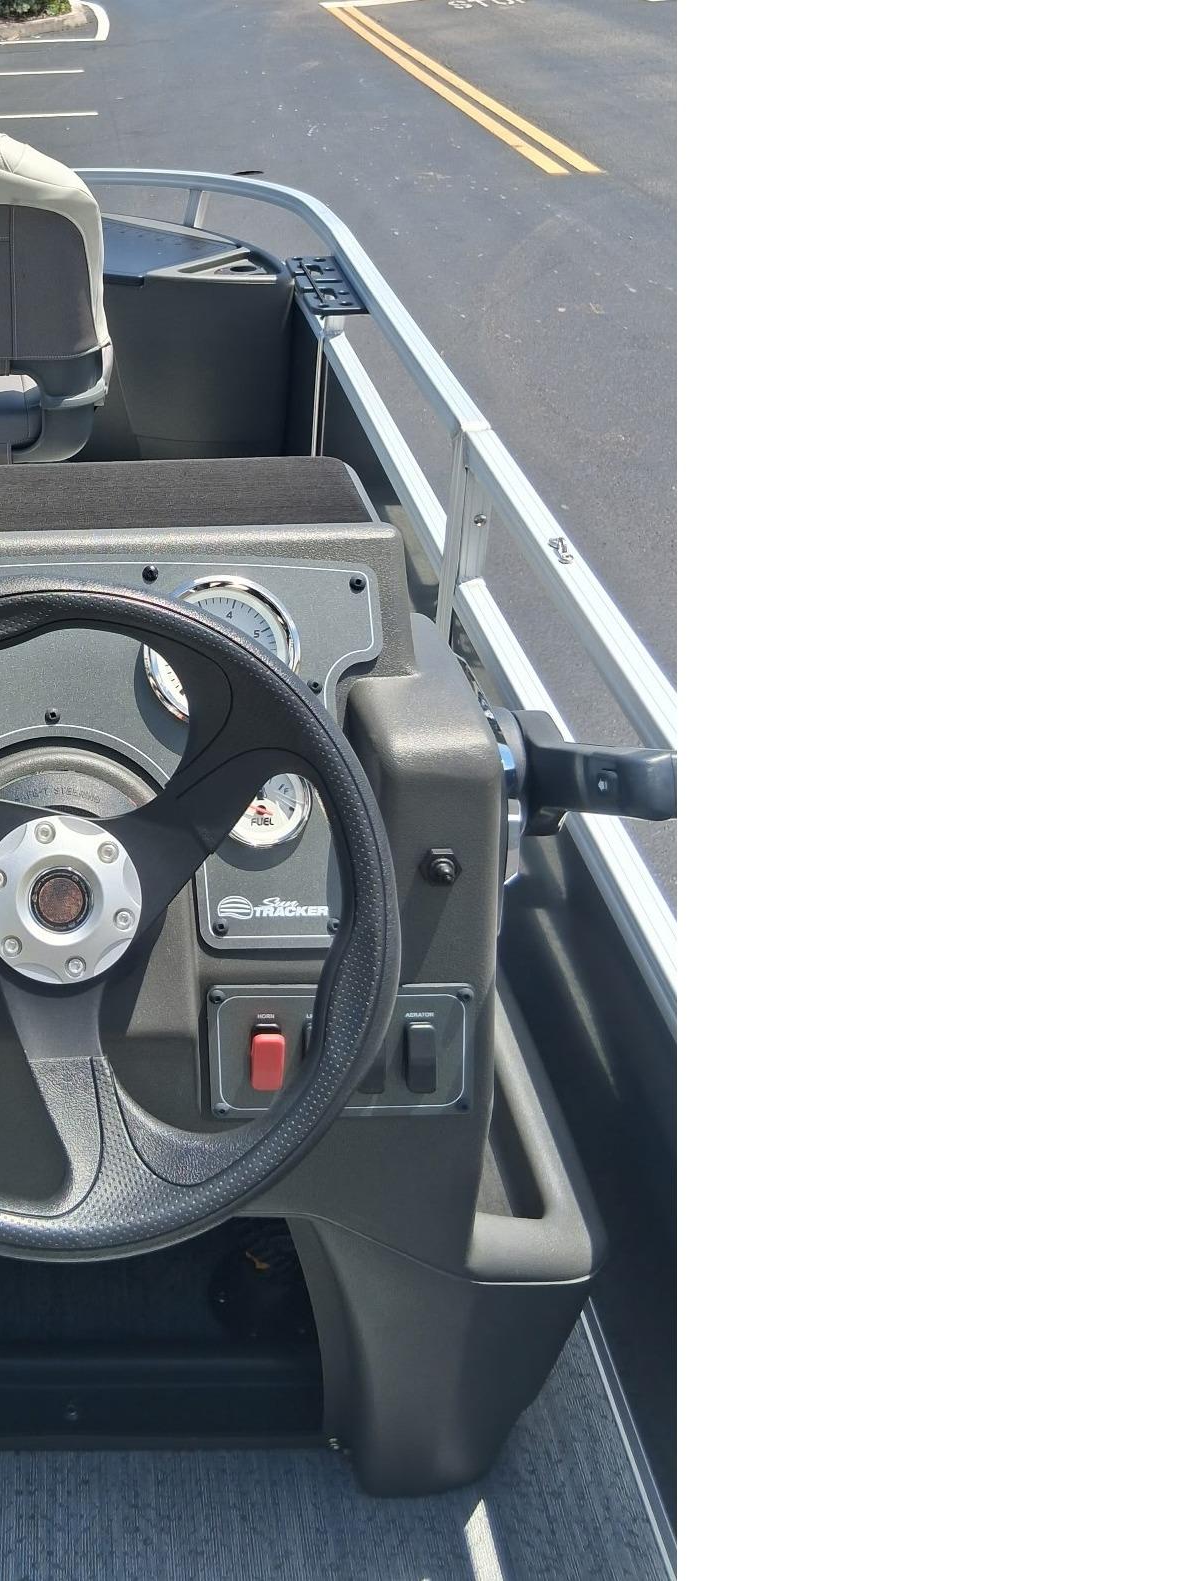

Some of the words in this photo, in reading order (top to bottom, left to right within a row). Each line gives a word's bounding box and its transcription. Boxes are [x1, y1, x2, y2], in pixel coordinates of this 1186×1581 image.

[225, 611, 233, 620] 4
[253, 629, 260, 638] 5
[250, 817, 274, 826] FUEL
[262, 896, 299, 907] Sun
[253, 905, 329, 917] TRACKER
